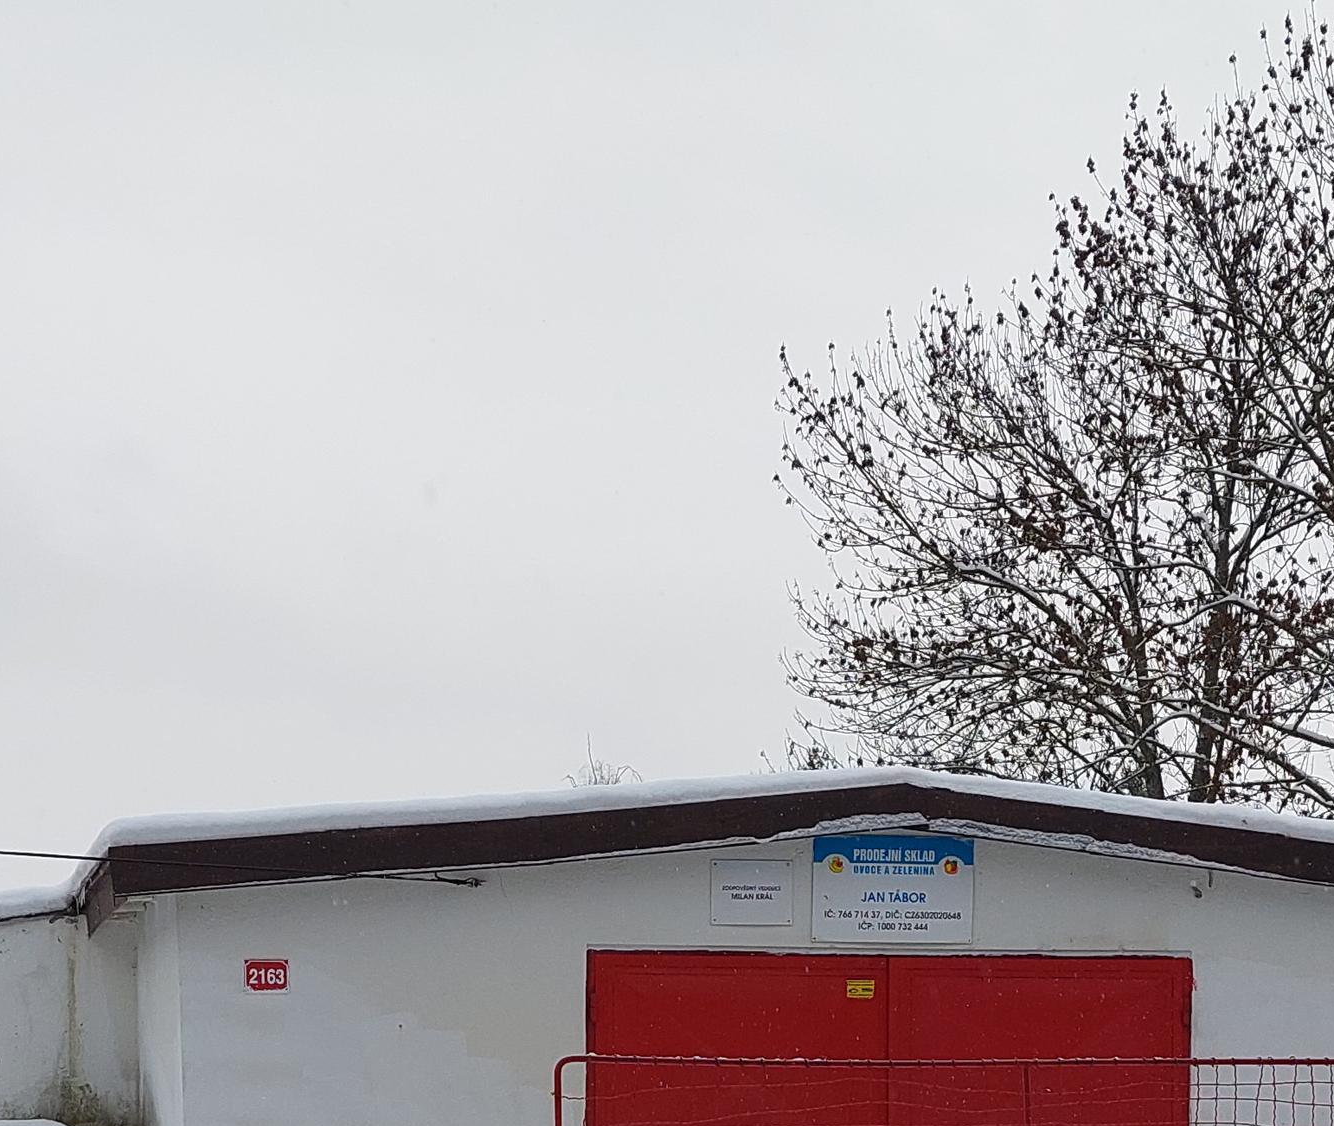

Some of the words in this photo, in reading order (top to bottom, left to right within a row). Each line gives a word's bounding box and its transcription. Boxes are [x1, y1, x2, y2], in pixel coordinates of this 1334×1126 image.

[853, 846, 902, 862] PRODEJNÍ
[904, 849, 935, 862] SKLAD
[853, 865, 882, 875] OVOCE
[883, 865, 890, 875] A
[892, 866, 935, 876] ZELENINA
[731, 893, 754, 901] MILAN
[755, 891, 774, 901] KRÁL
[861, 891, 885, 903] JAN
[888, 888, 927, 903] TÁBOR
[824, 908, 836, 919] IČ:
[838, 910, 853, 919] 766
[855, 910, 869, 919] 714
[877, 922, 896, 931] 1000
[898, 922, 913, 931] 732
[913, 923, 929, 931] 444
[249, 968, 285, 985] 2163
